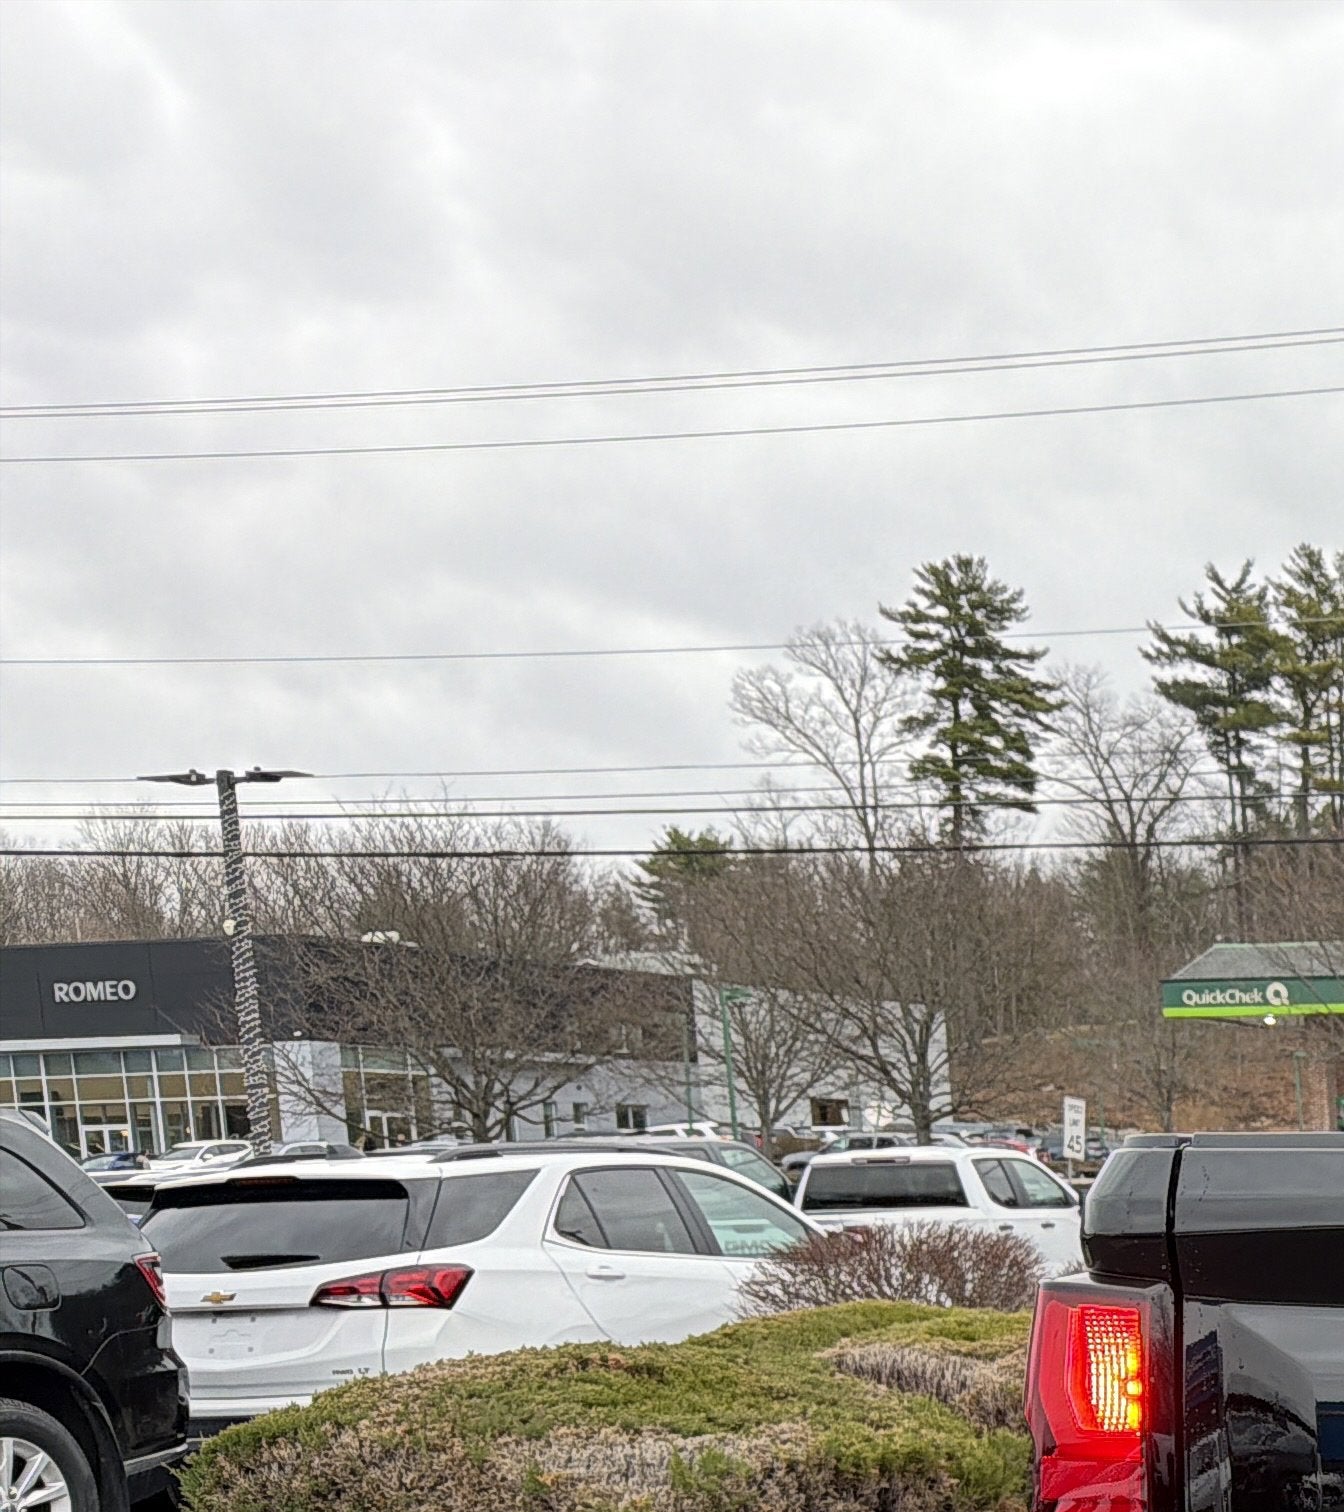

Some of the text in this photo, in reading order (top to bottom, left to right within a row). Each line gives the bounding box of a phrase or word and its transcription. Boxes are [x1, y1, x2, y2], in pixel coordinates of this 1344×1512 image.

[53, 980, 136, 1003] ROMEO
[1182, 988, 1264, 1006] QuickChek
[1067, 1135, 1082, 1153] 45
